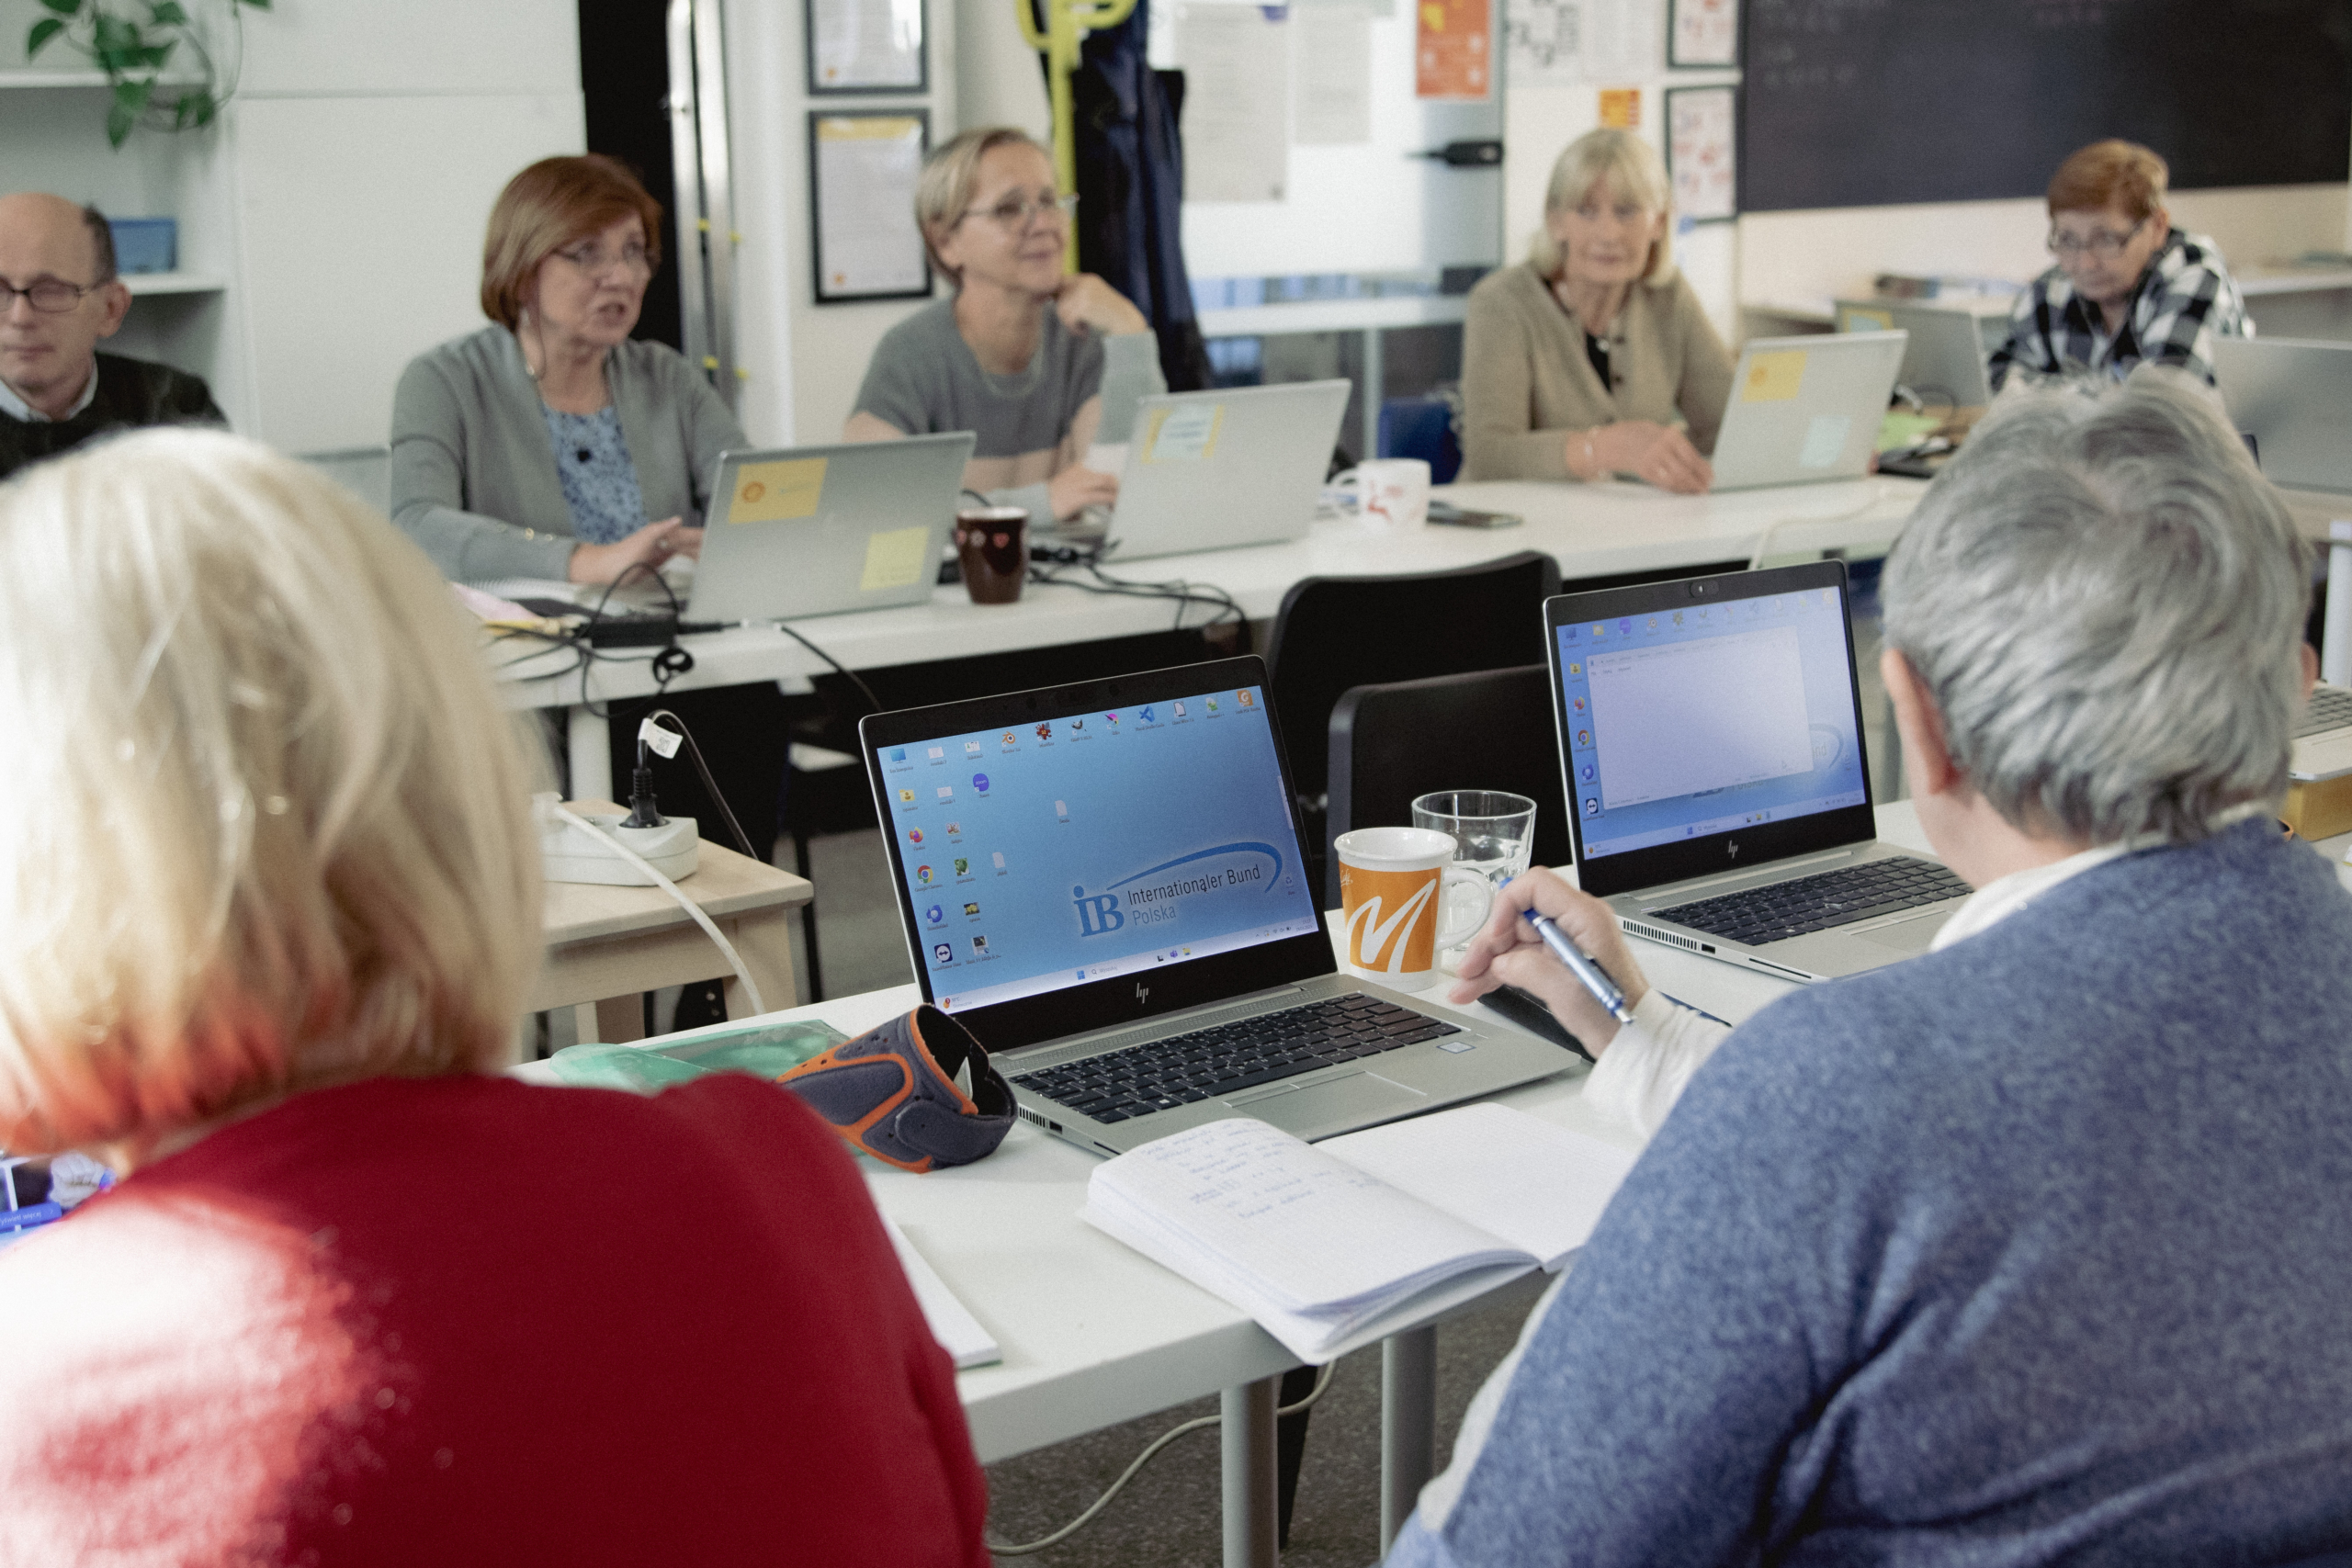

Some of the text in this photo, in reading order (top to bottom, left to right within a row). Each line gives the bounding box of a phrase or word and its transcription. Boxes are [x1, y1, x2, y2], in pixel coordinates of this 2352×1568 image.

[1128, 863, 1261, 906] Internationaler Bund
[1132, 904, 1177, 927] Polska
